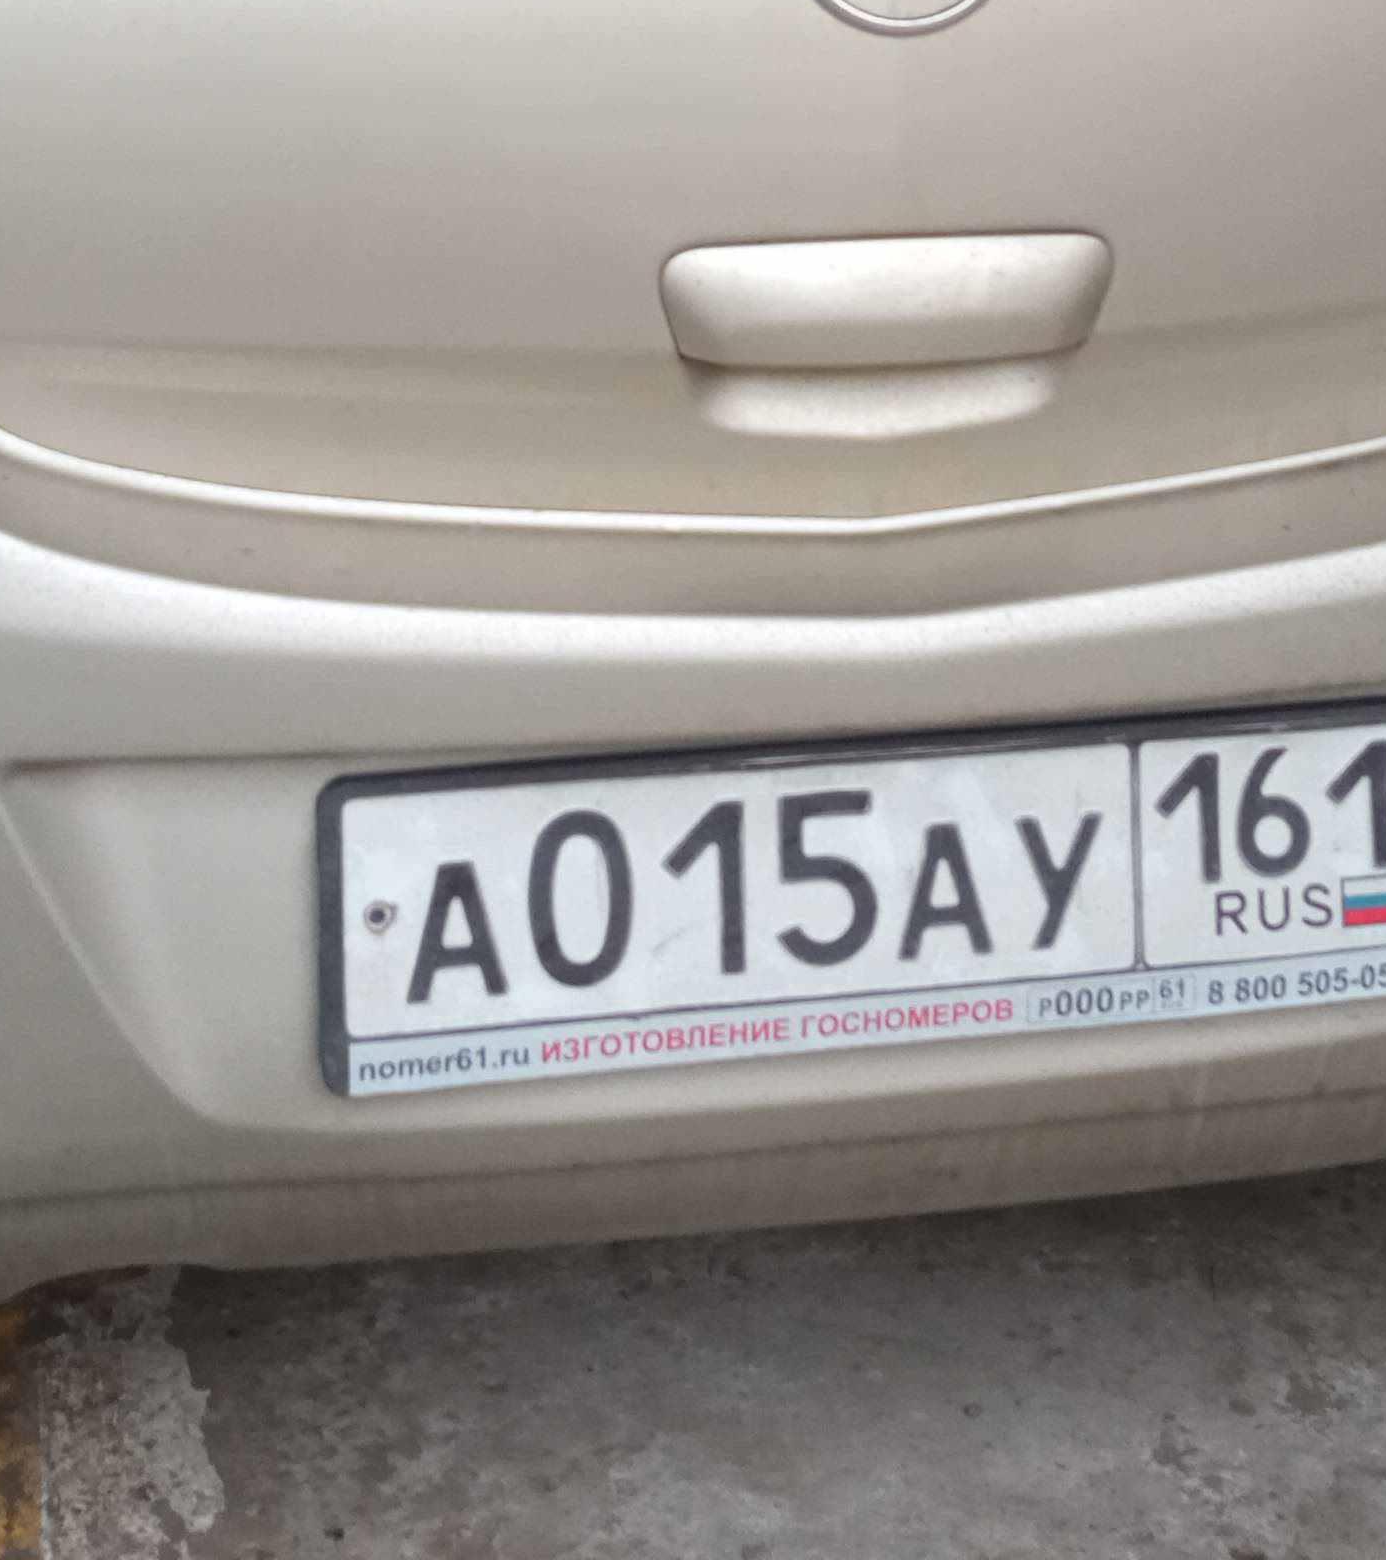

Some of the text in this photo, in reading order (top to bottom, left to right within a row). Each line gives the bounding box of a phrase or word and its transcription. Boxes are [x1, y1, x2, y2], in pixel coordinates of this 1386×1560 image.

[1214, 885, 1334, 937] RUS
[359, 1045, 530, 1082] nomer61.ru
[541, 1018, 791, 1064] ИЗГОТОВЛЕНИЕ
[801, 998, 1013, 1044] ГОСНОМЕРОВ
[1208, 981, 1224, 1005] 8
[1236, 974, 1287, 1004] 800
